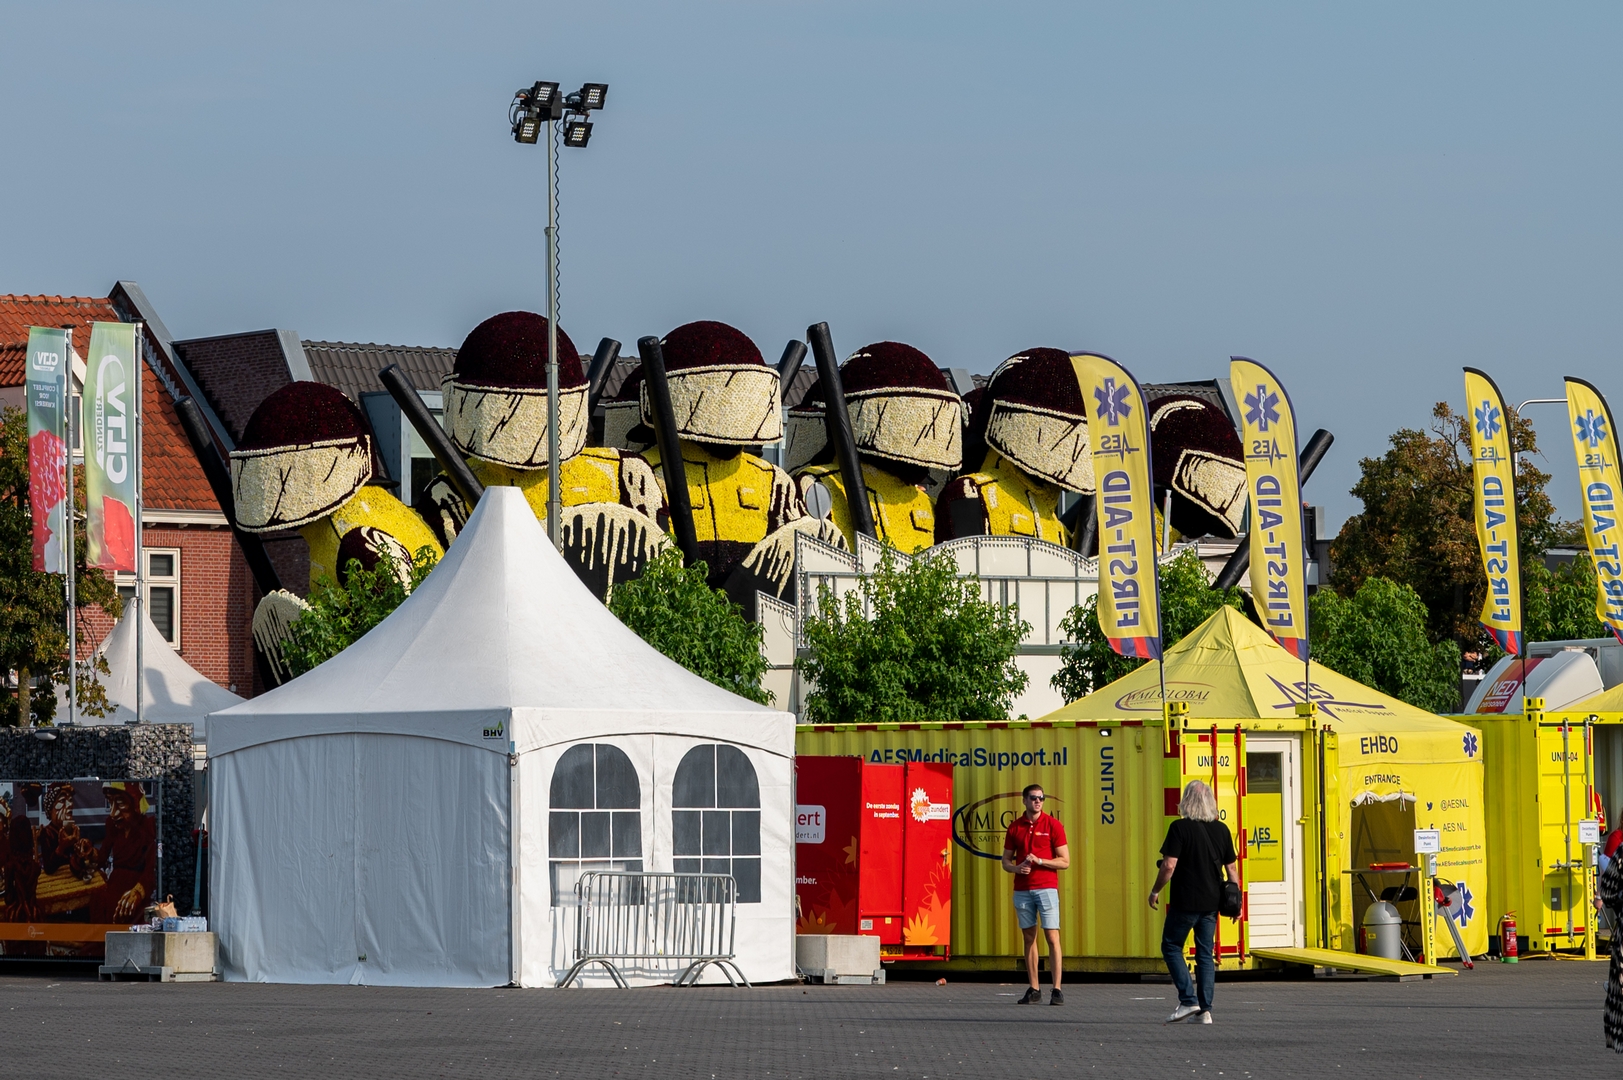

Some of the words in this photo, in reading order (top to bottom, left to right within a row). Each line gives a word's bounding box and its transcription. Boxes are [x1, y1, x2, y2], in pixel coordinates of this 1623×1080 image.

[1487, 680, 1518, 696] NED.
[483, 729, 503, 737] BHV
[1360, 735, 1399, 755] EHBO
[868, 746, 1068, 771] AESMedicalSupport.nl
[1197, 755, 1230, 767] UNI-02
[1100, 746, 1115, 825] UNIT-02
[1364, 773, 1401, 786] ENTRANCE
[1440, 798, 1470, 811] @AESNL
[797, 811, 821, 826] ert
[1443, 822, 1456, 832] AES
[1457, 821, 1467, 831] NL
[796, 875, 818, 885] mber.
[1426, 880, 1434, 965] DESINFECTIE
